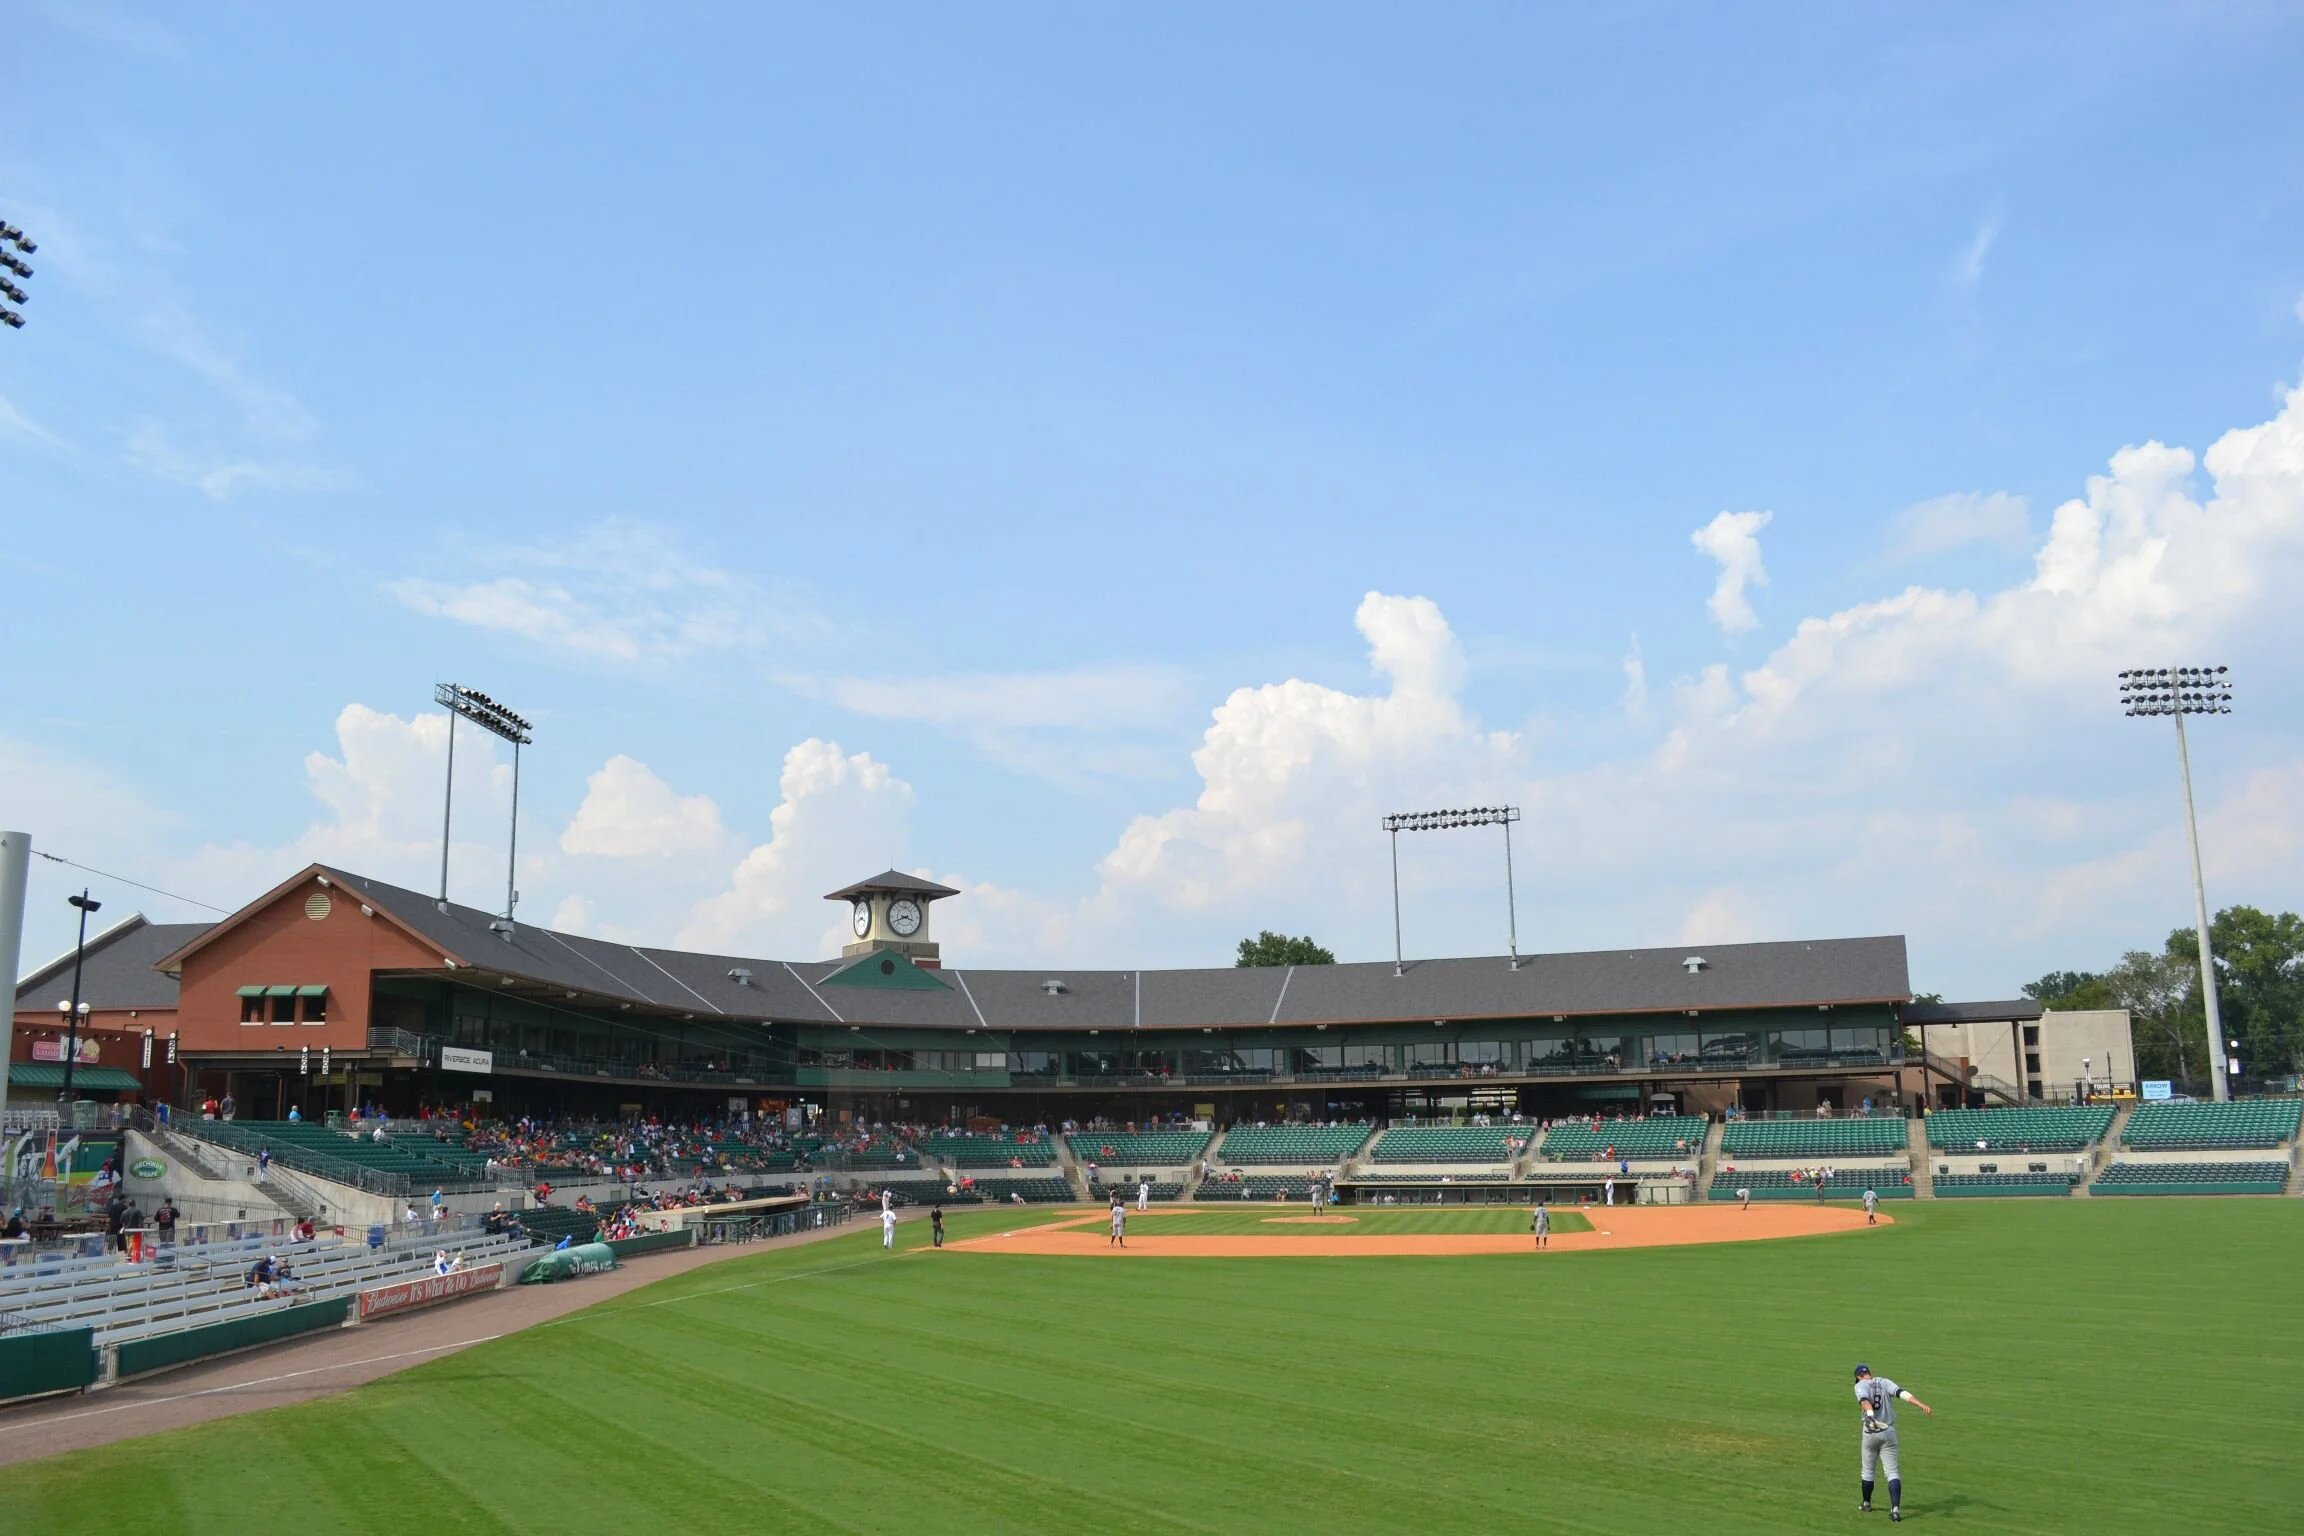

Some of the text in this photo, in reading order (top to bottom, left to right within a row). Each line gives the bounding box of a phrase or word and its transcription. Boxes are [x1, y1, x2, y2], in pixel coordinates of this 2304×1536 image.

[444, 1054, 490, 1066] RIVERSIDE ACURA
[367, 1290, 409, 1313] Budweiser
[410, 1281, 423, 1303] It's
[426, 1278, 446, 1298] What
[470, 1269, 501, 1289] Budweiser
[1872, 1394, 1882, 1411] 8
